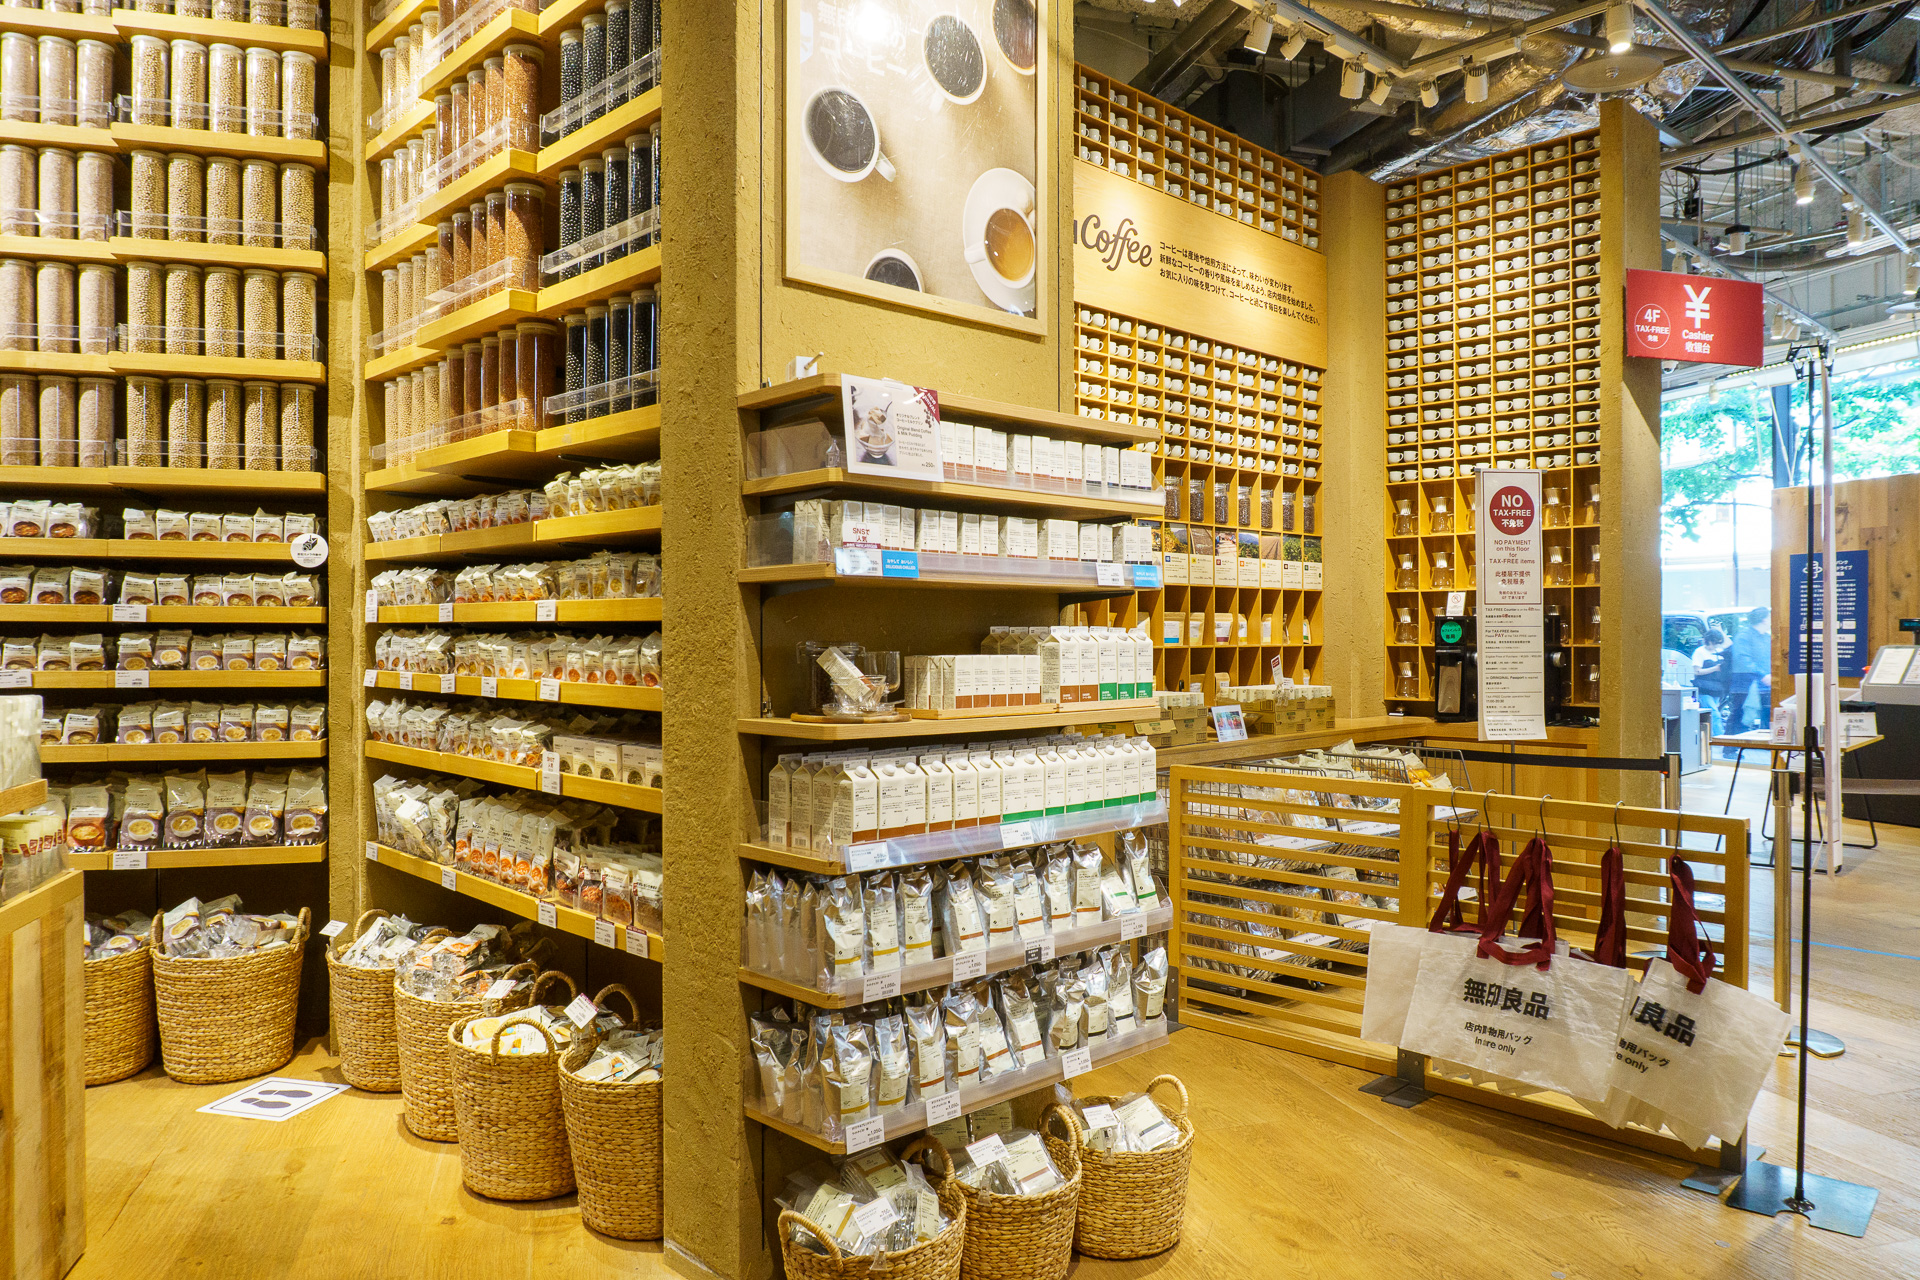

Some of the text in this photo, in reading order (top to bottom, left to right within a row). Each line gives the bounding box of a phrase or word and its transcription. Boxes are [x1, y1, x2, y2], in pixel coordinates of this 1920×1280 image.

[1080, 213, 1153, 272] Coffee
[1644, 308, 1661, 323] 4F
[1635, 324, 1670, 335] TAX-FREE
[1681, 329, 1714, 342] Cashier
[1501, 494, 1524, 508] NO
[1492, 509, 1532, 517] TAX-FREE
[1463, 977, 1550, 1021] 無印良品
[1629, 996, 1696, 1048] 良品
[1497, 1043, 1516, 1056] only
[1624, 1057, 1649, 1074] only
